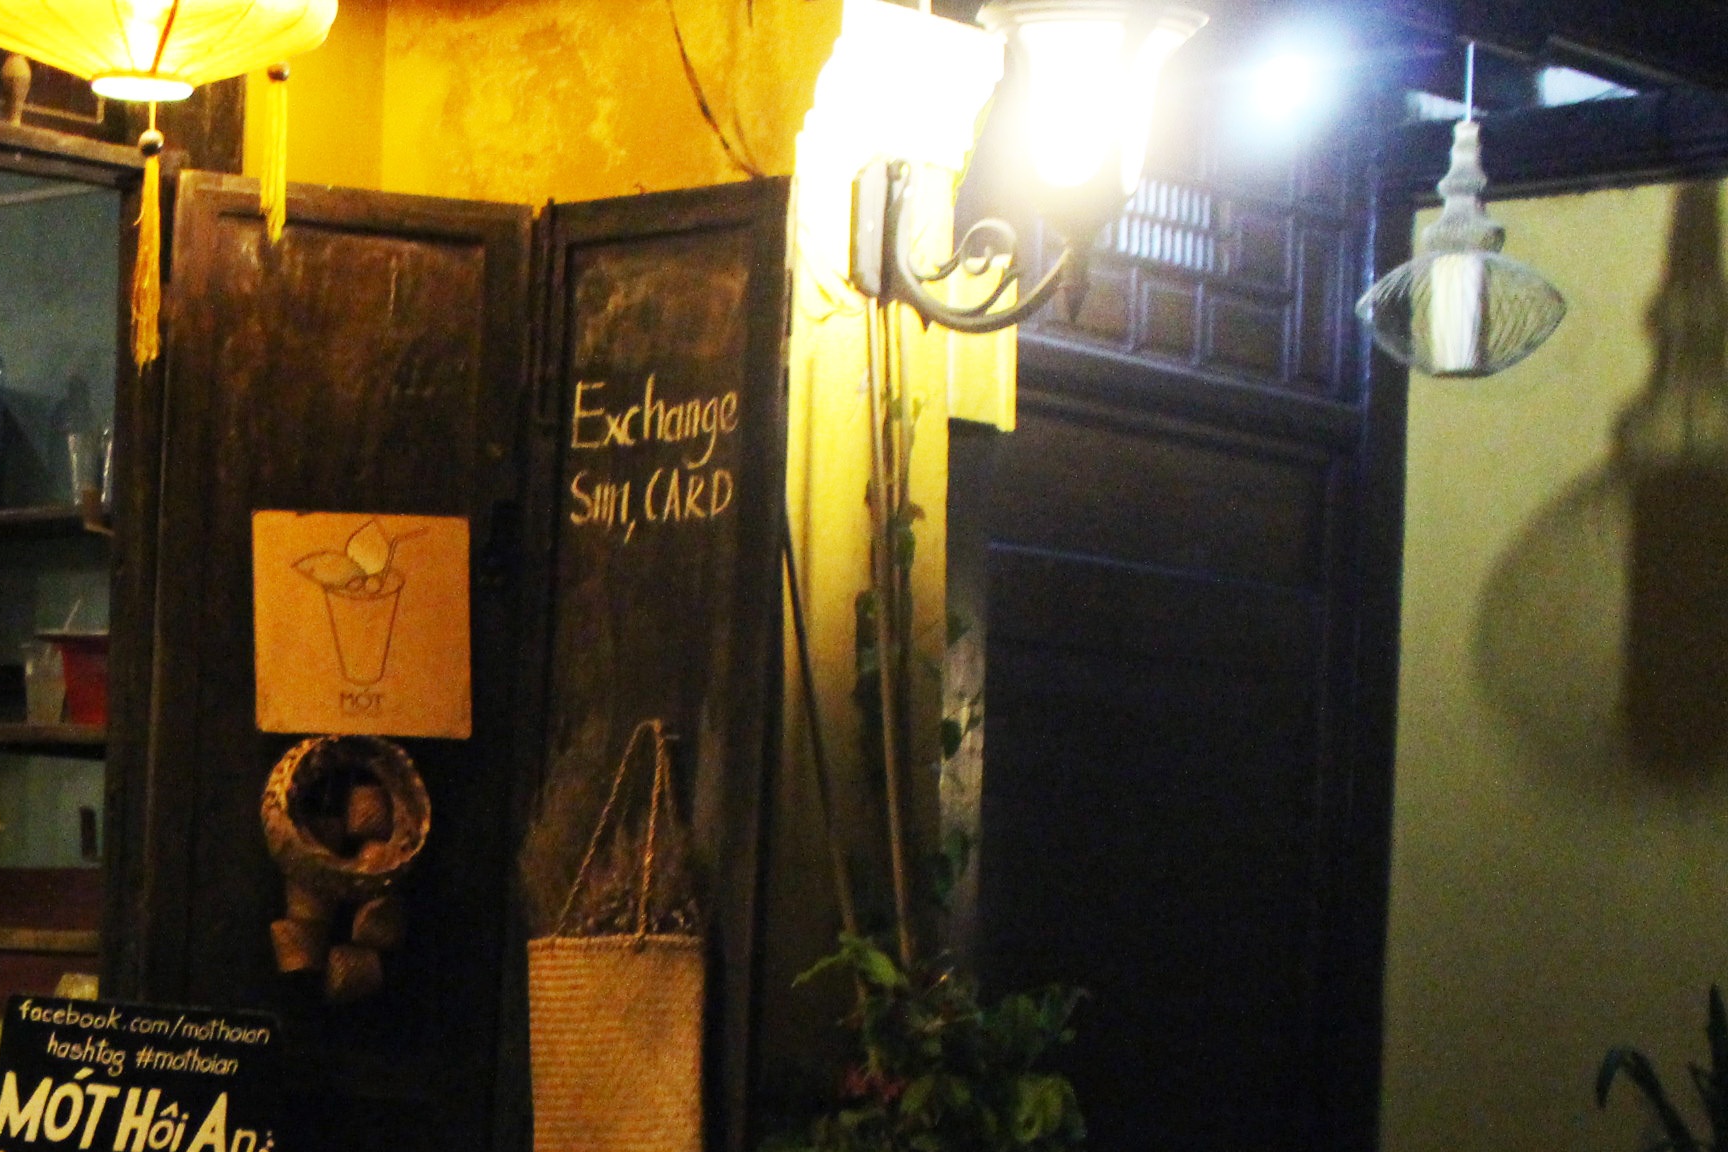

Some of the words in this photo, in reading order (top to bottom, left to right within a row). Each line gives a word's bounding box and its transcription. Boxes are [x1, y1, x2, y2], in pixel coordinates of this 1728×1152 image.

[571, 372, 740, 470] Exchange
[644, 467, 735, 522] CARD
[18, 999, 271, 1046] facebook.com/mothoian
[46, 1032, 126, 1077] hashtag
[135, 1046, 239, 1076] #mothoian
